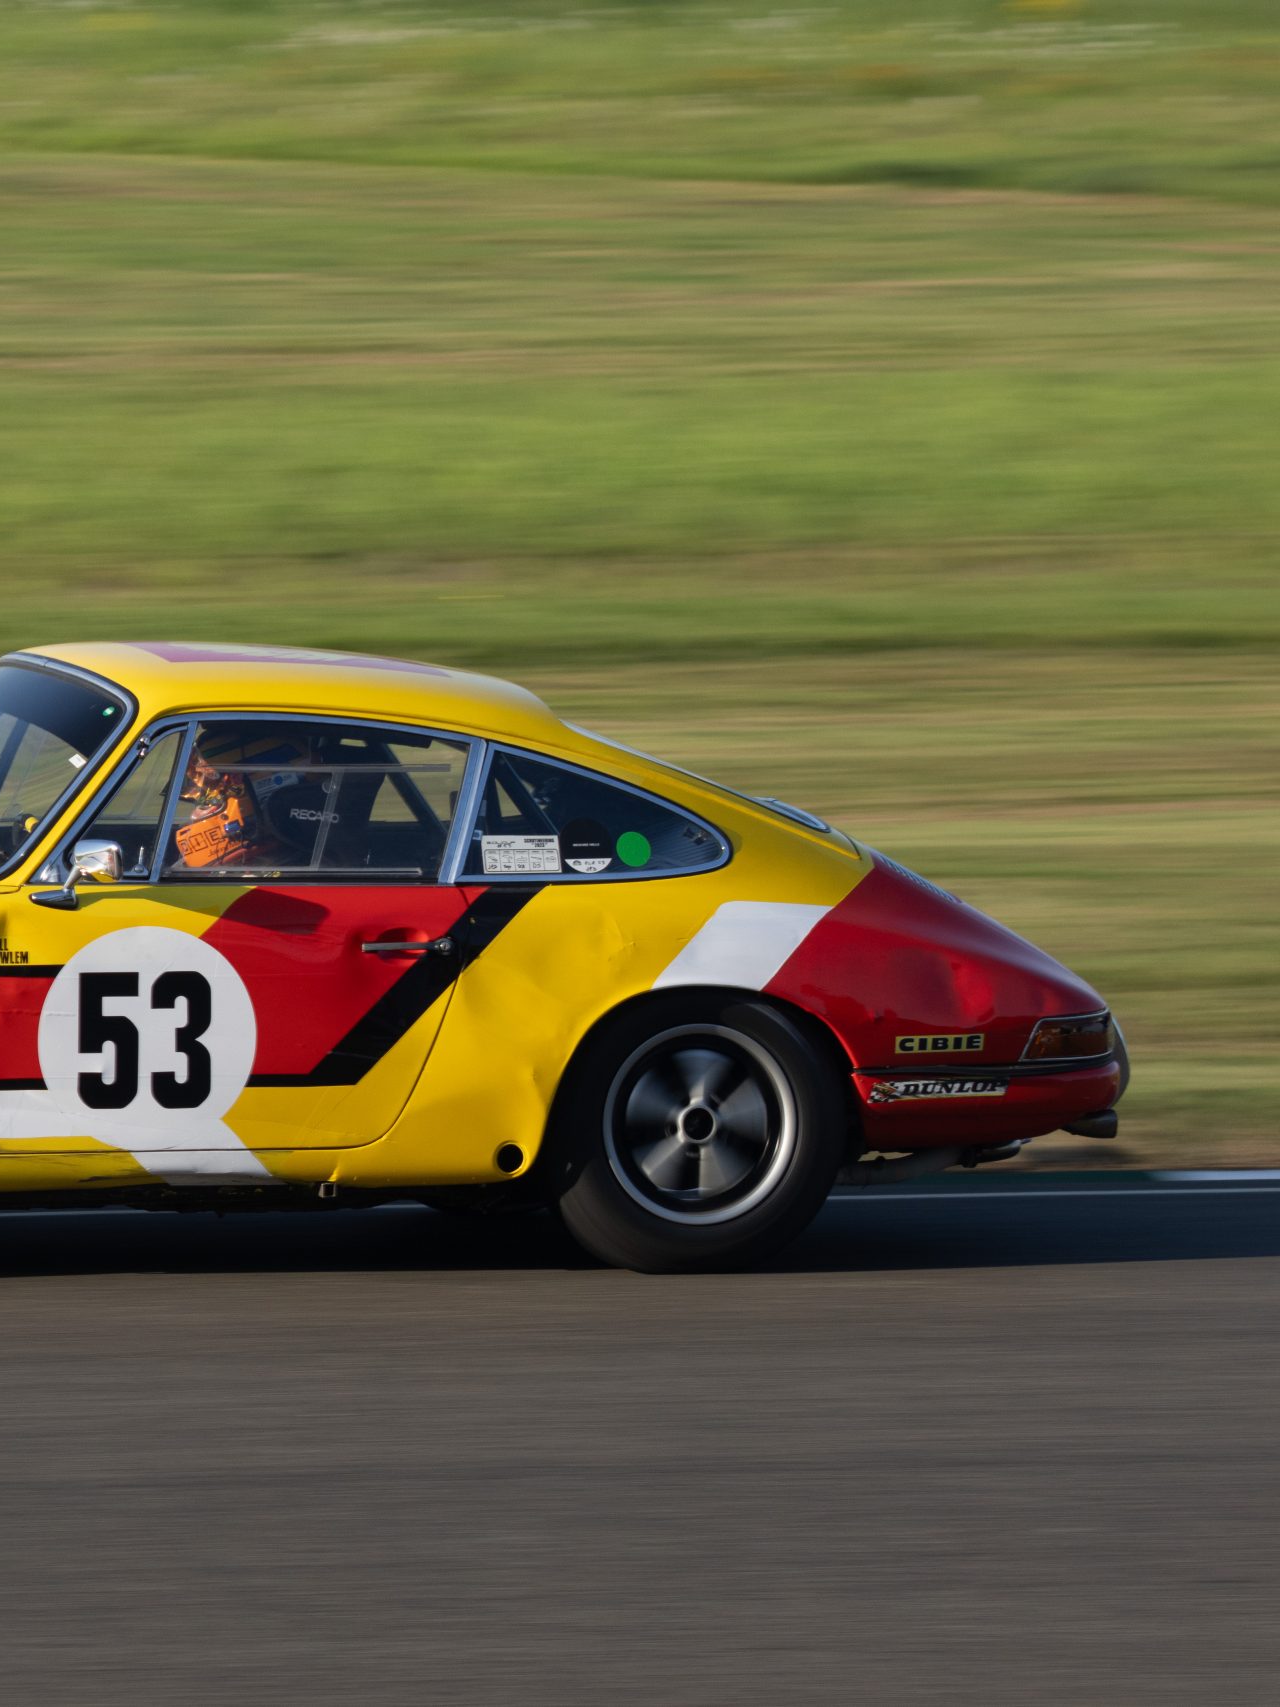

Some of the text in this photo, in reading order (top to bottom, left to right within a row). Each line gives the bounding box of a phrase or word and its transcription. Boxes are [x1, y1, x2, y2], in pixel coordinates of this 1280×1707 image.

[77, 970, 212, 1110] 53
[898, 1035, 982, 1052] CIBIE
[901, 1079, 1006, 1096] DUNLOP
